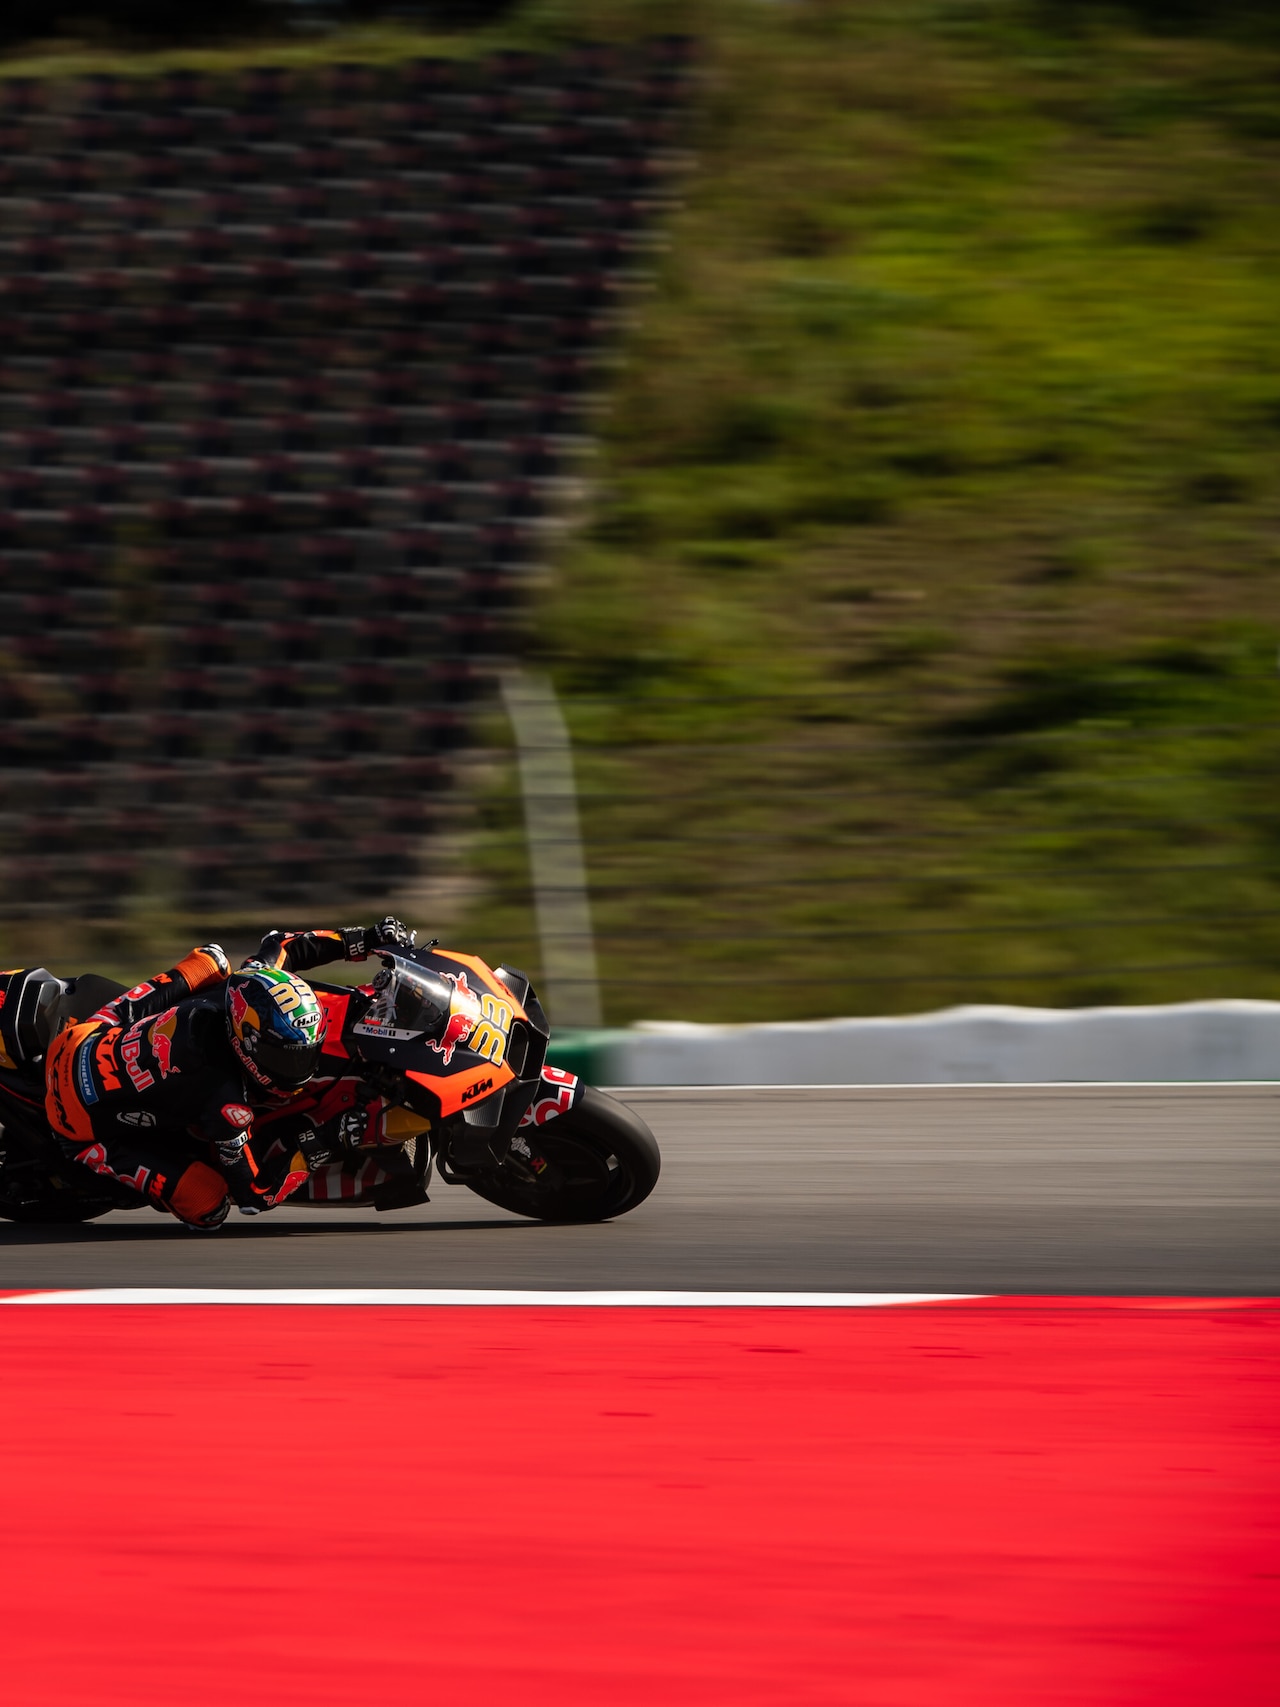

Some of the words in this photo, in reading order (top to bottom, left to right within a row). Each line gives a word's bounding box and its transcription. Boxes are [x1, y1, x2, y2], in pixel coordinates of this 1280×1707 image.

[296, 1012, 319, 1027] HJC
[365, 1026, 388, 1036] Mobil
[468, 993, 514, 1066] 33
[81, 1045, 93, 1097] MICHELIN
[95, 1026, 124, 1092] KTM
[121, 1040, 156, 1093] Bull
[461, 1078, 494, 1104] KTM
